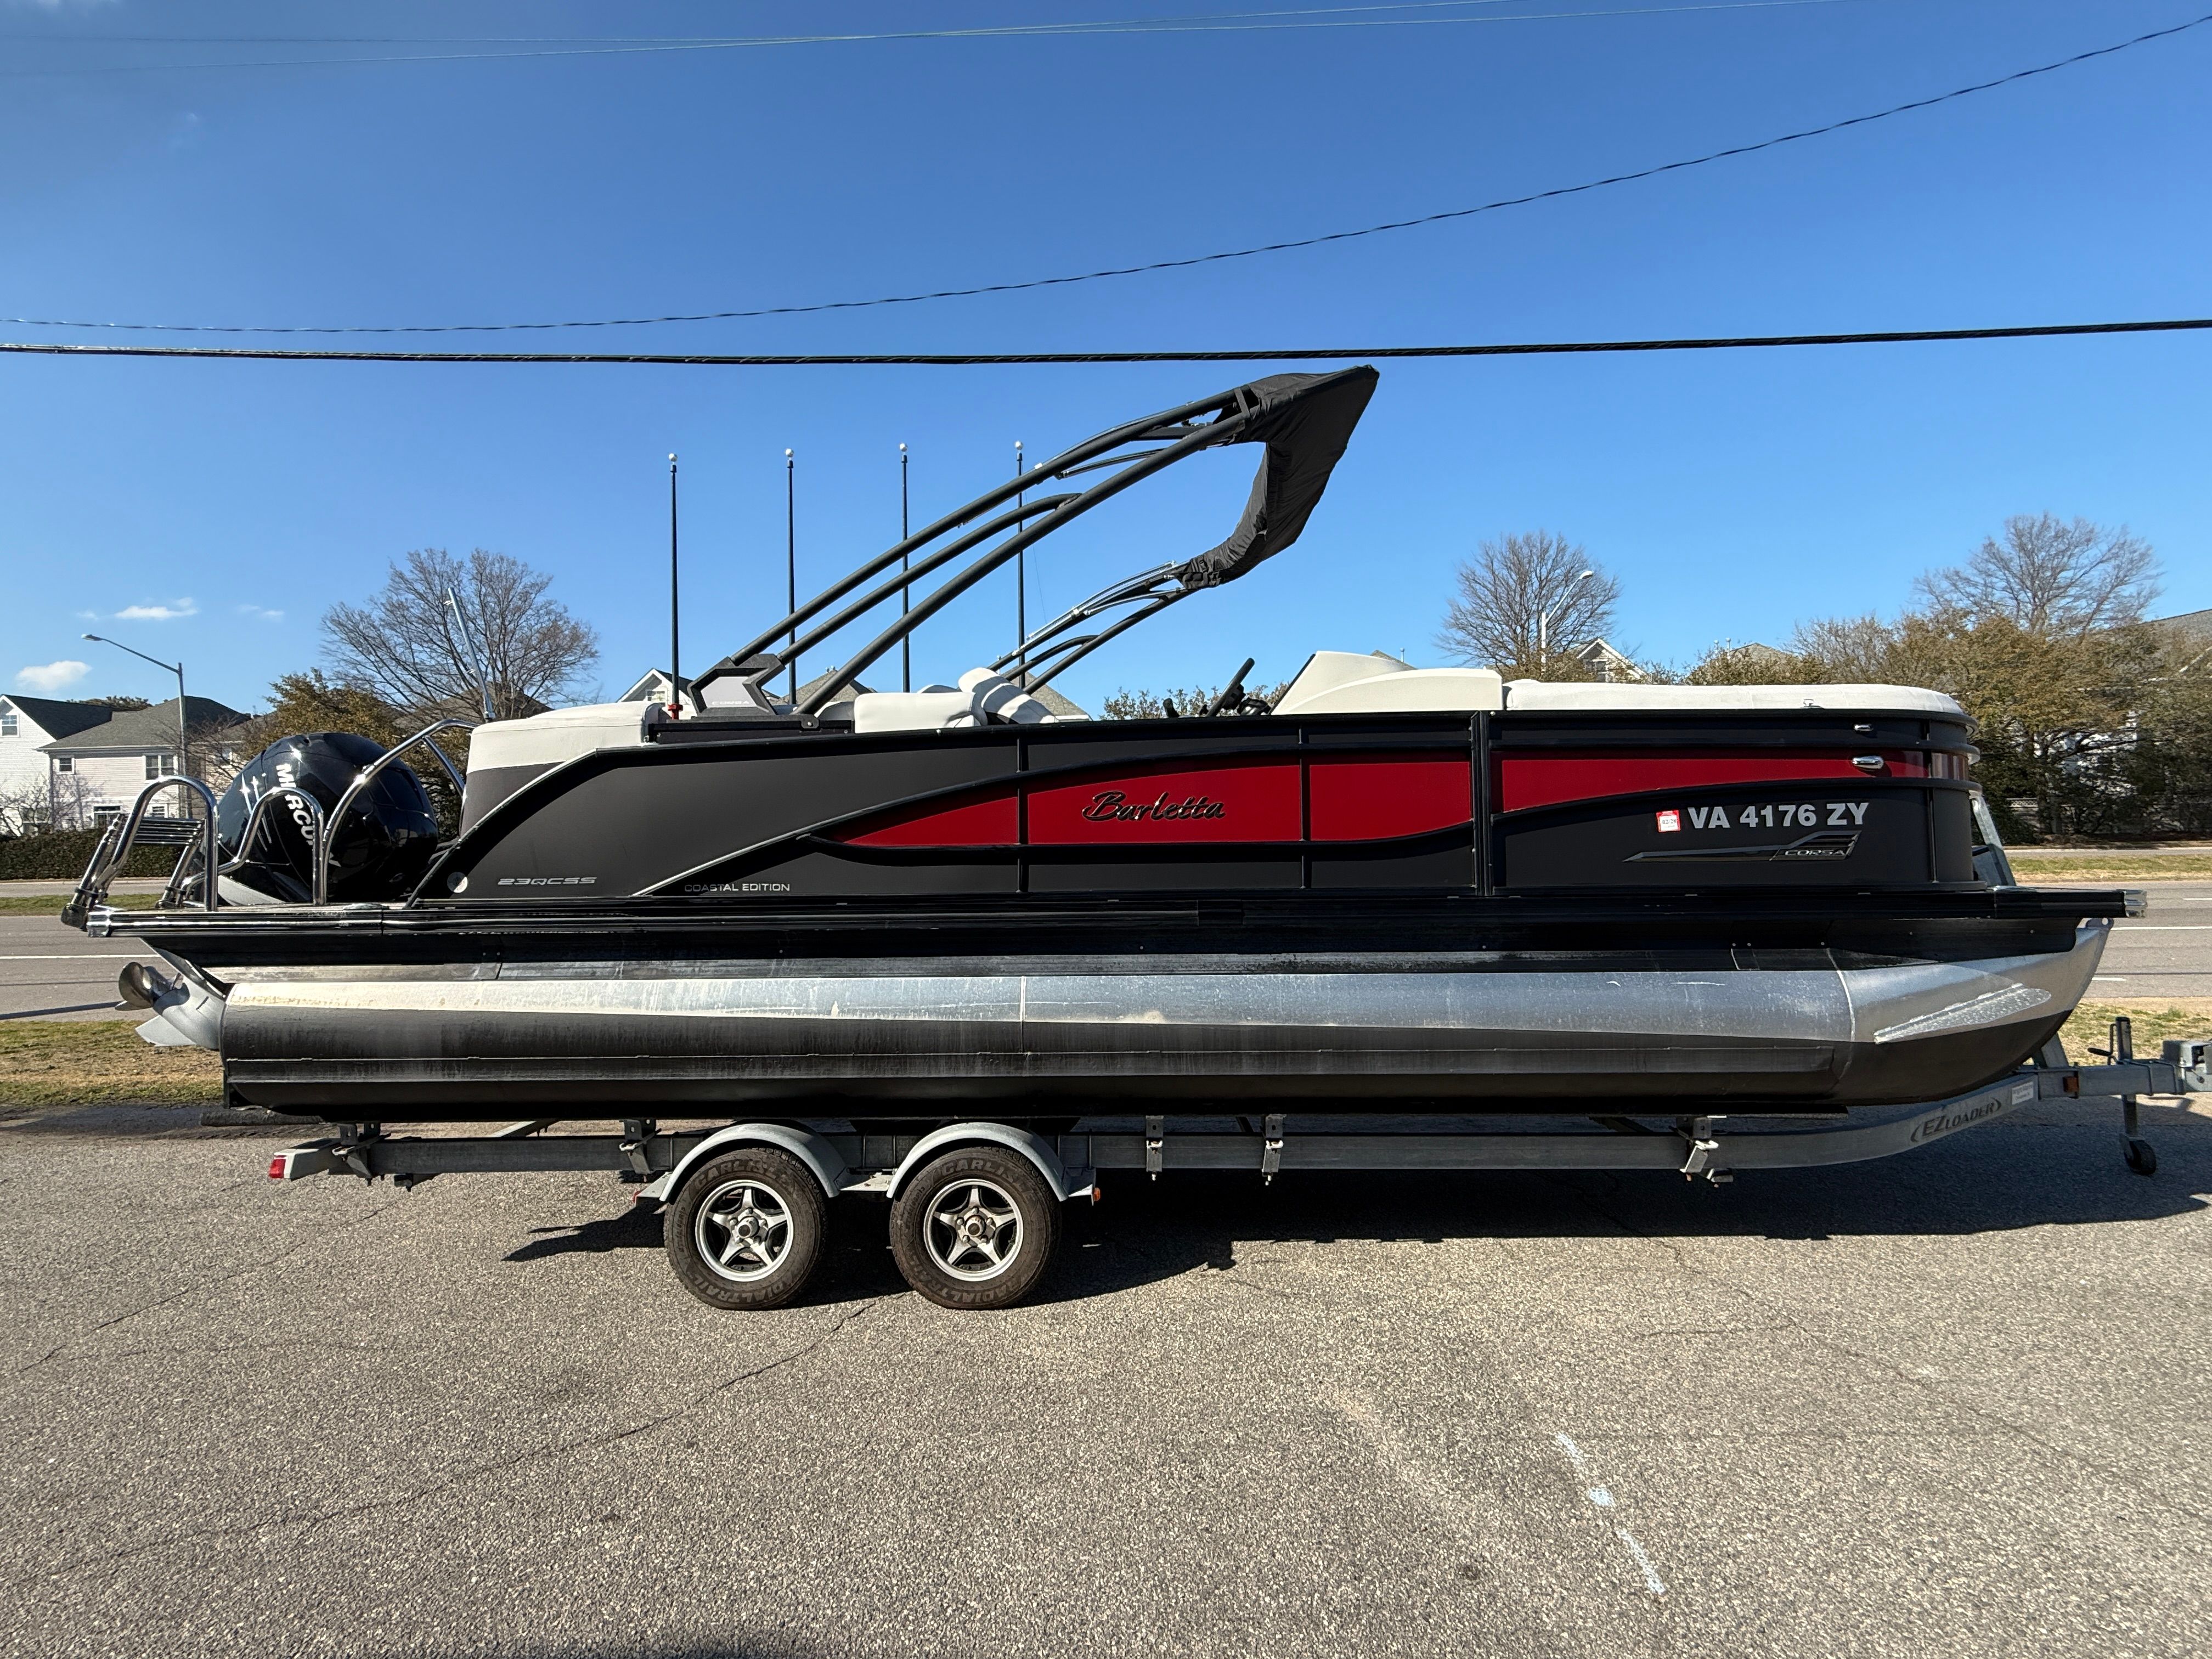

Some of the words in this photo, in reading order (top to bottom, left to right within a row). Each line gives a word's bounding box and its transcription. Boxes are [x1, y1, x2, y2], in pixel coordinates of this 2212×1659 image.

[276, 763, 341, 867] MRCUY
[1082, 791, 1226, 822] Barletta
[1688, 806, 1730, 829] VA
[1740, 805, 1816, 827] 4176
[1826, 802, 1869, 826] ZY
[498, 877, 597, 885] 23QCSS
[742, 883, 790, 891] EDITION
